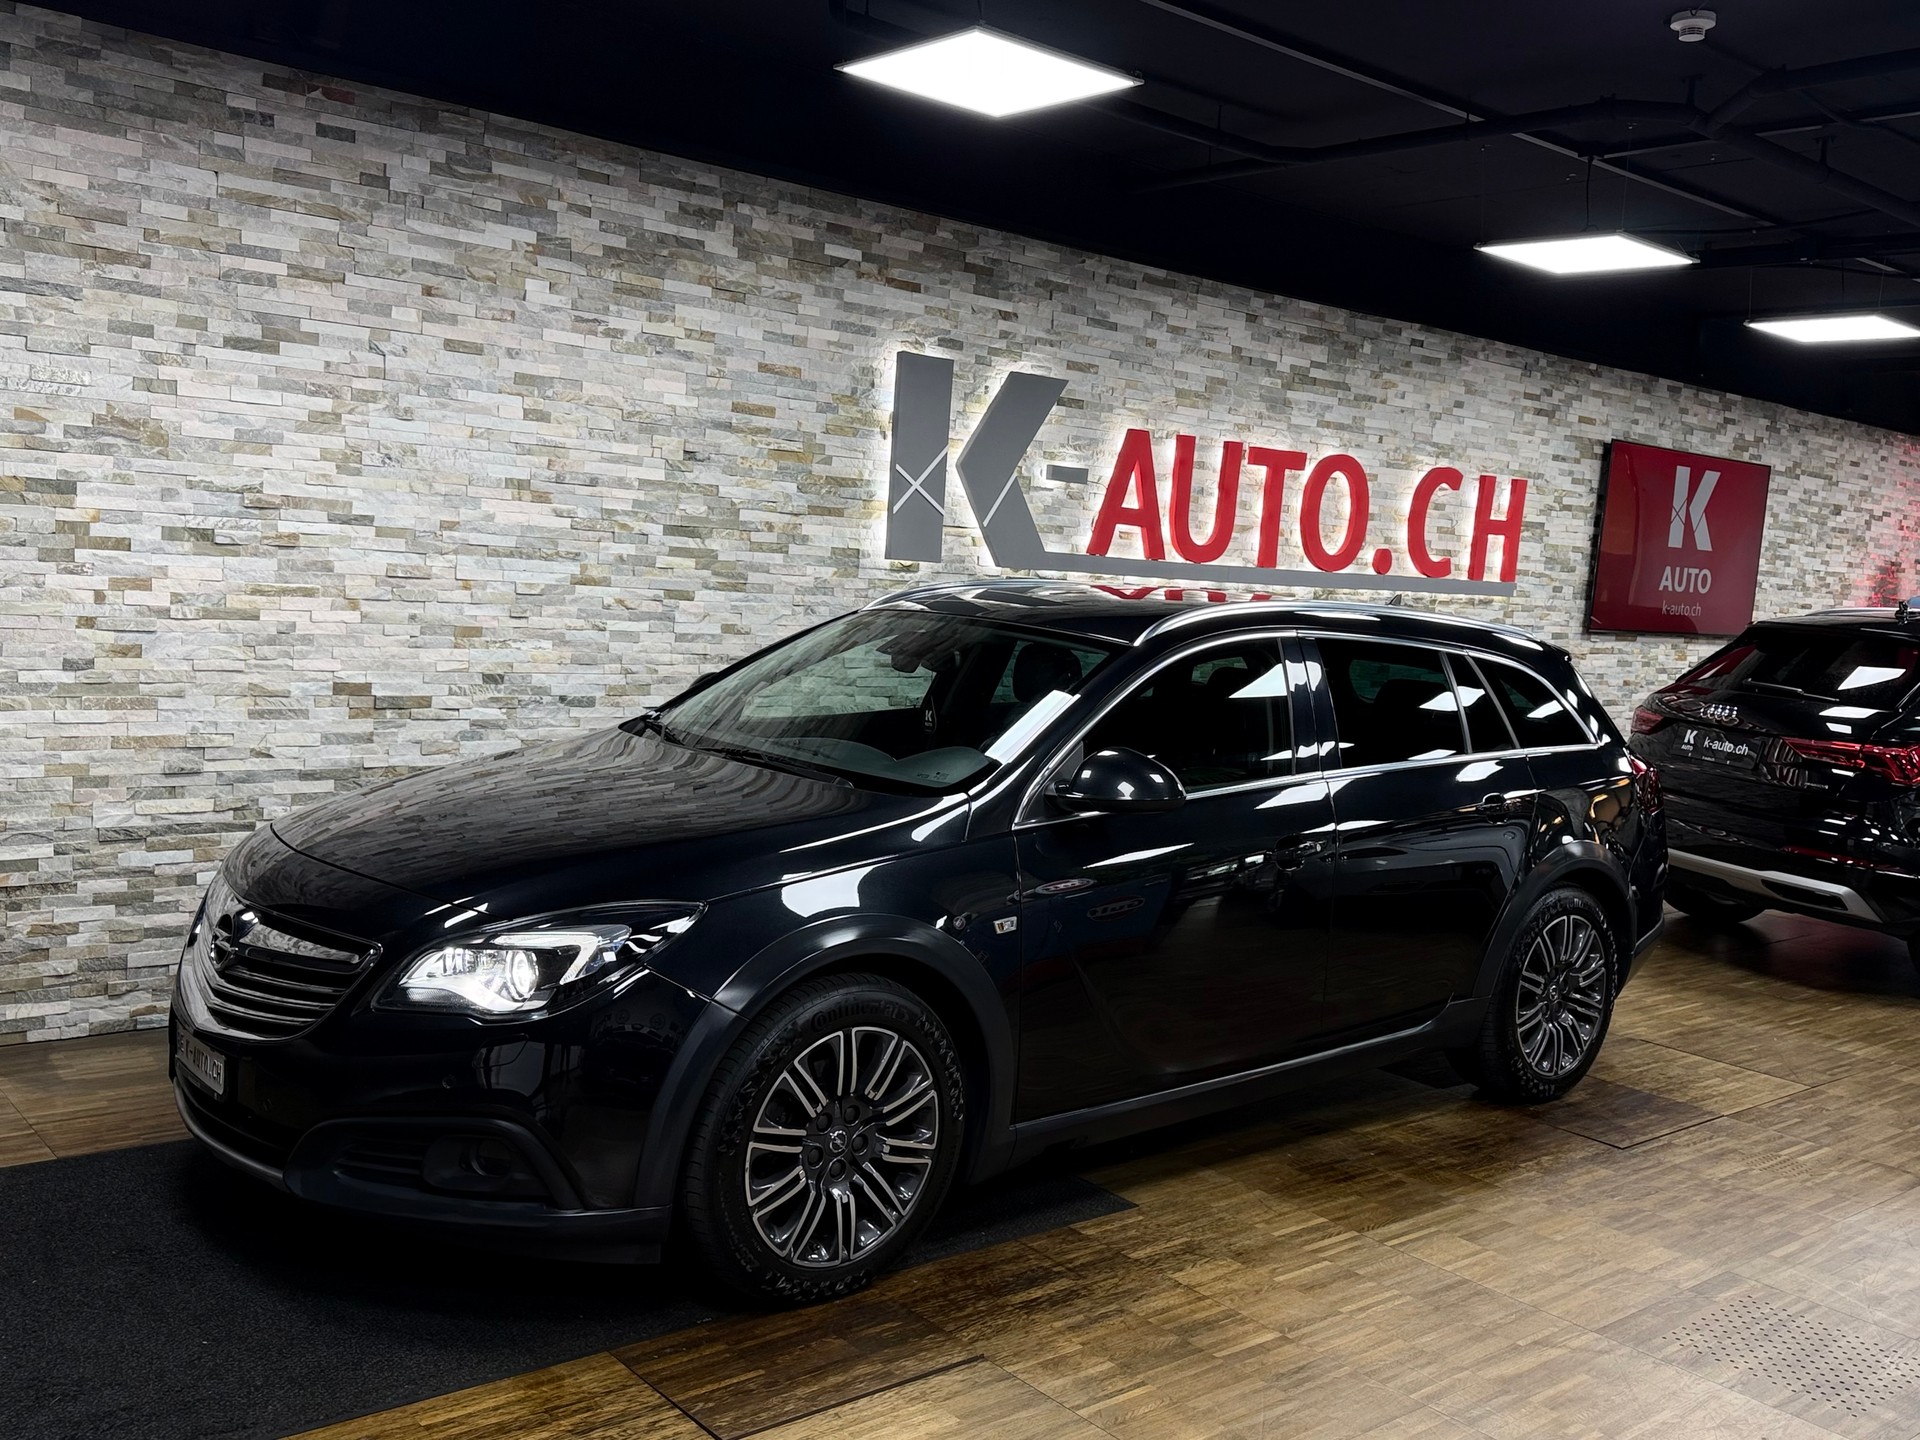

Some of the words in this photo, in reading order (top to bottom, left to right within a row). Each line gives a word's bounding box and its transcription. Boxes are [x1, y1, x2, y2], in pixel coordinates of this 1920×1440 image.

[885, 351, 1528, 583] K-AUTO.CH
[1667, 465, 1722, 552] K
[1658, 565, 1712, 594] AUTO
[1661, 600, 1702, 617] k-auto.ch
[1683, 729, 1698, 744] K
[1703, 736, 1749, 756] k-auto.ch
